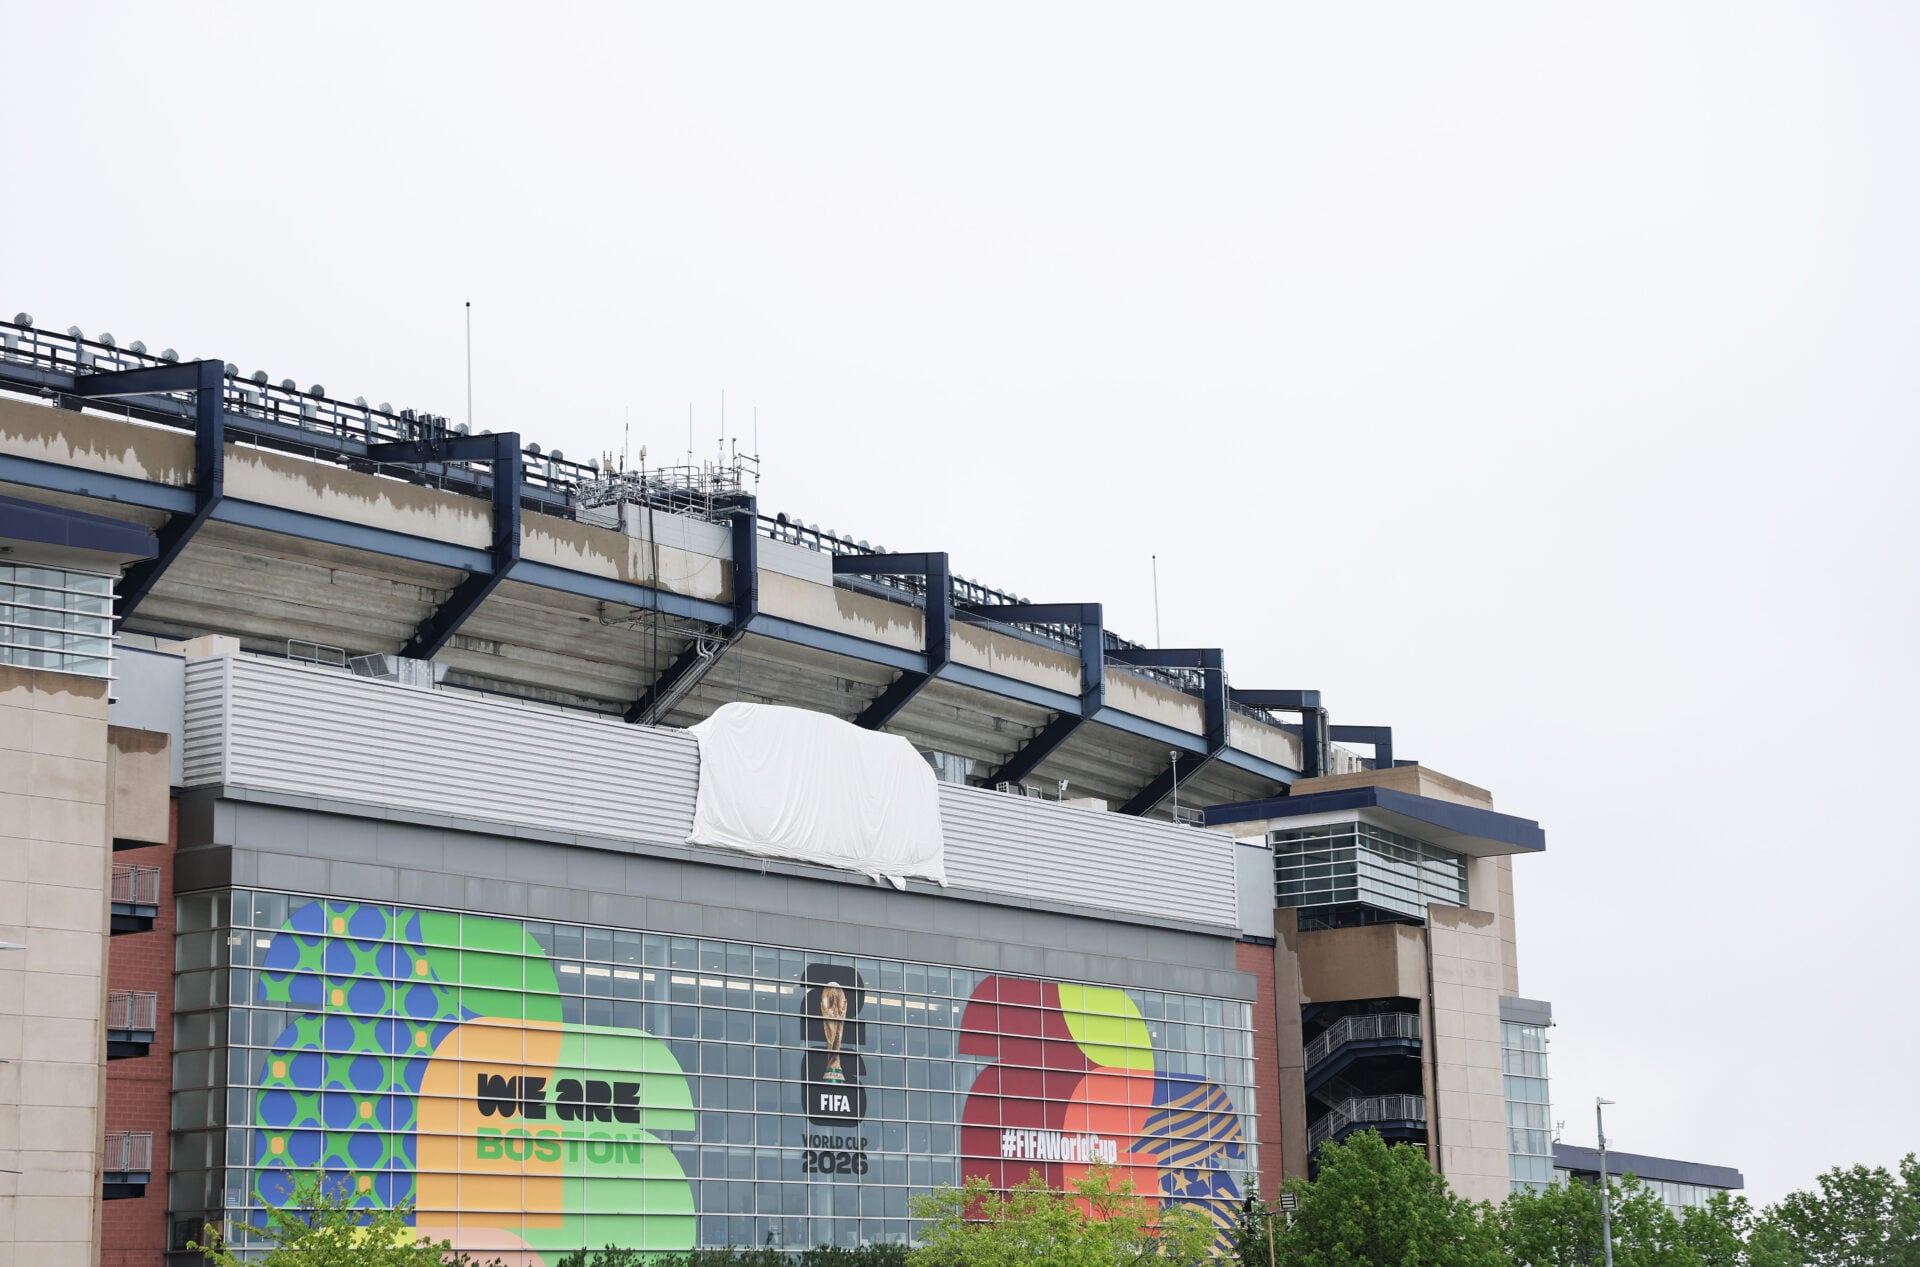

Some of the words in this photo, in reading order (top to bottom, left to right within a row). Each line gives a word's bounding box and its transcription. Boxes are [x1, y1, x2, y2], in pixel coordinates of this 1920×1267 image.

[477, 1073, 547, 1120] WE
[820, 1093, 851, 1112] FIFA
[477, 1127, 641, 1164] BOSTON
[802, 1134, 843, 1149] WORLD
[846, 1136, 868, 1151] CUP
[1002, 1129, 1117, 1168] #FIFAWorldCup
[802, 1150, 868, 1175] 2026
